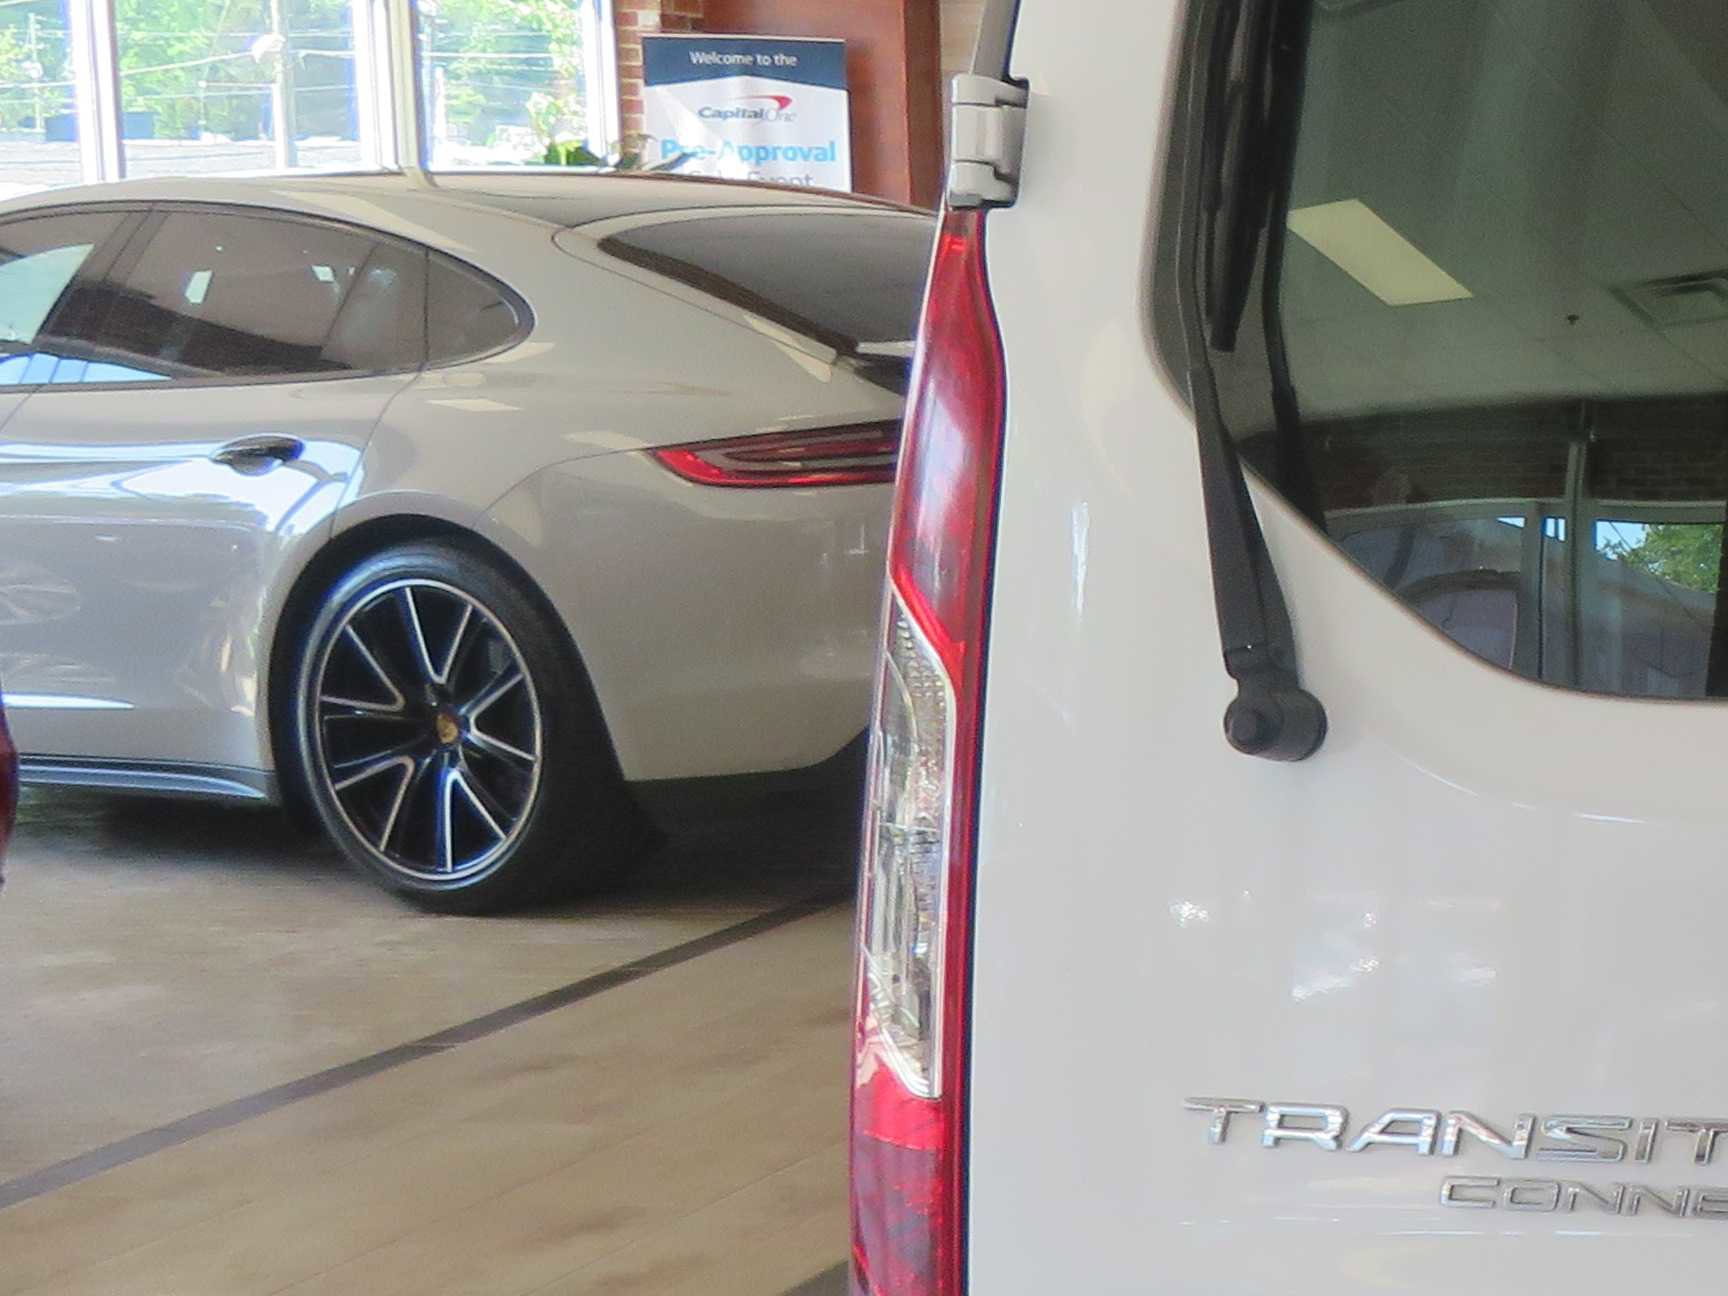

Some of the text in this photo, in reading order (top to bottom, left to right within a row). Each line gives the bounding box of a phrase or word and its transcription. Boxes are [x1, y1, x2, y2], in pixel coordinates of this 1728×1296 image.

[689, 51, 797, 66] Welcome to the
